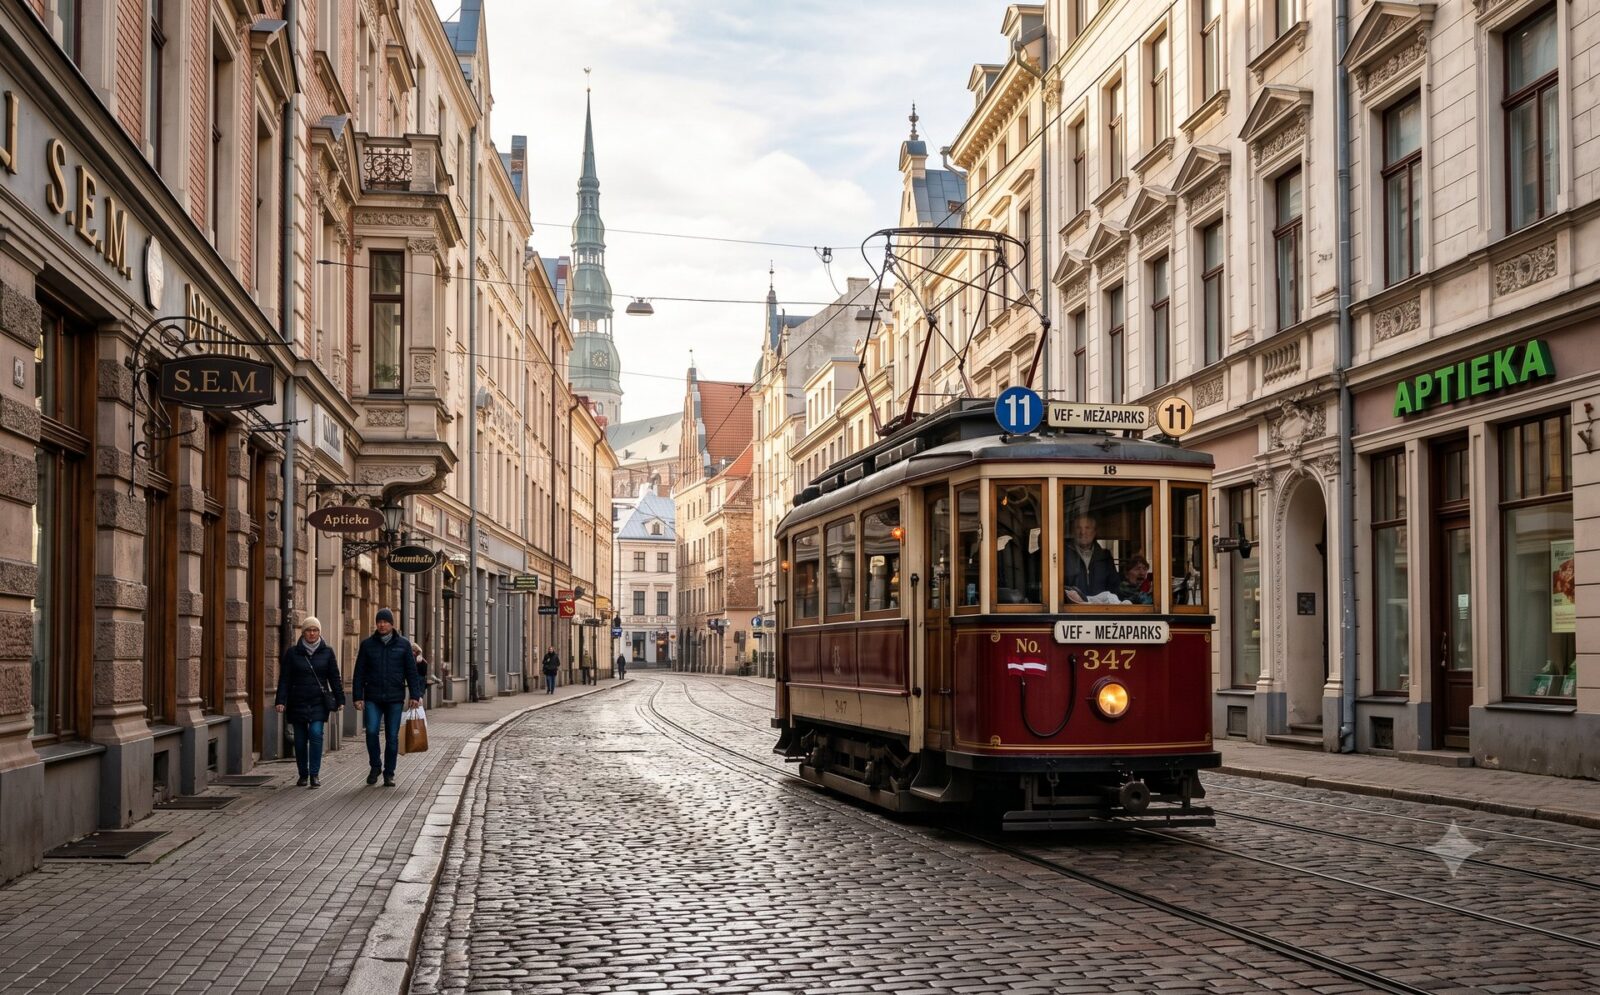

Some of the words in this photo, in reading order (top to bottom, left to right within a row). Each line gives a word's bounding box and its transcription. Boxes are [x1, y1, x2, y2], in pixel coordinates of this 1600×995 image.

[46, 137, 133, 281] S.E.M.
[174, 369, 263, 393] S.E.M.
[1392, 339, 1550, 417] APTIEKA
[1004, 394, 1031, 427] 11
[1053, 408, 1074, 422] VEF
[1083, 406, 1145, 425] MEŽAPARKS
[1164, 404, 1187, 430] 11
[1103, 465, 1117, 475] 18
[323, 513, 370, 527] Aptieka
[1062, 624, 1083, 640] VEF
[1095, 622, 1162, 641] MEŽAPARKS
[1015, 638, 1042, 653] No.
[1083, 649, 1136, 670] 347
